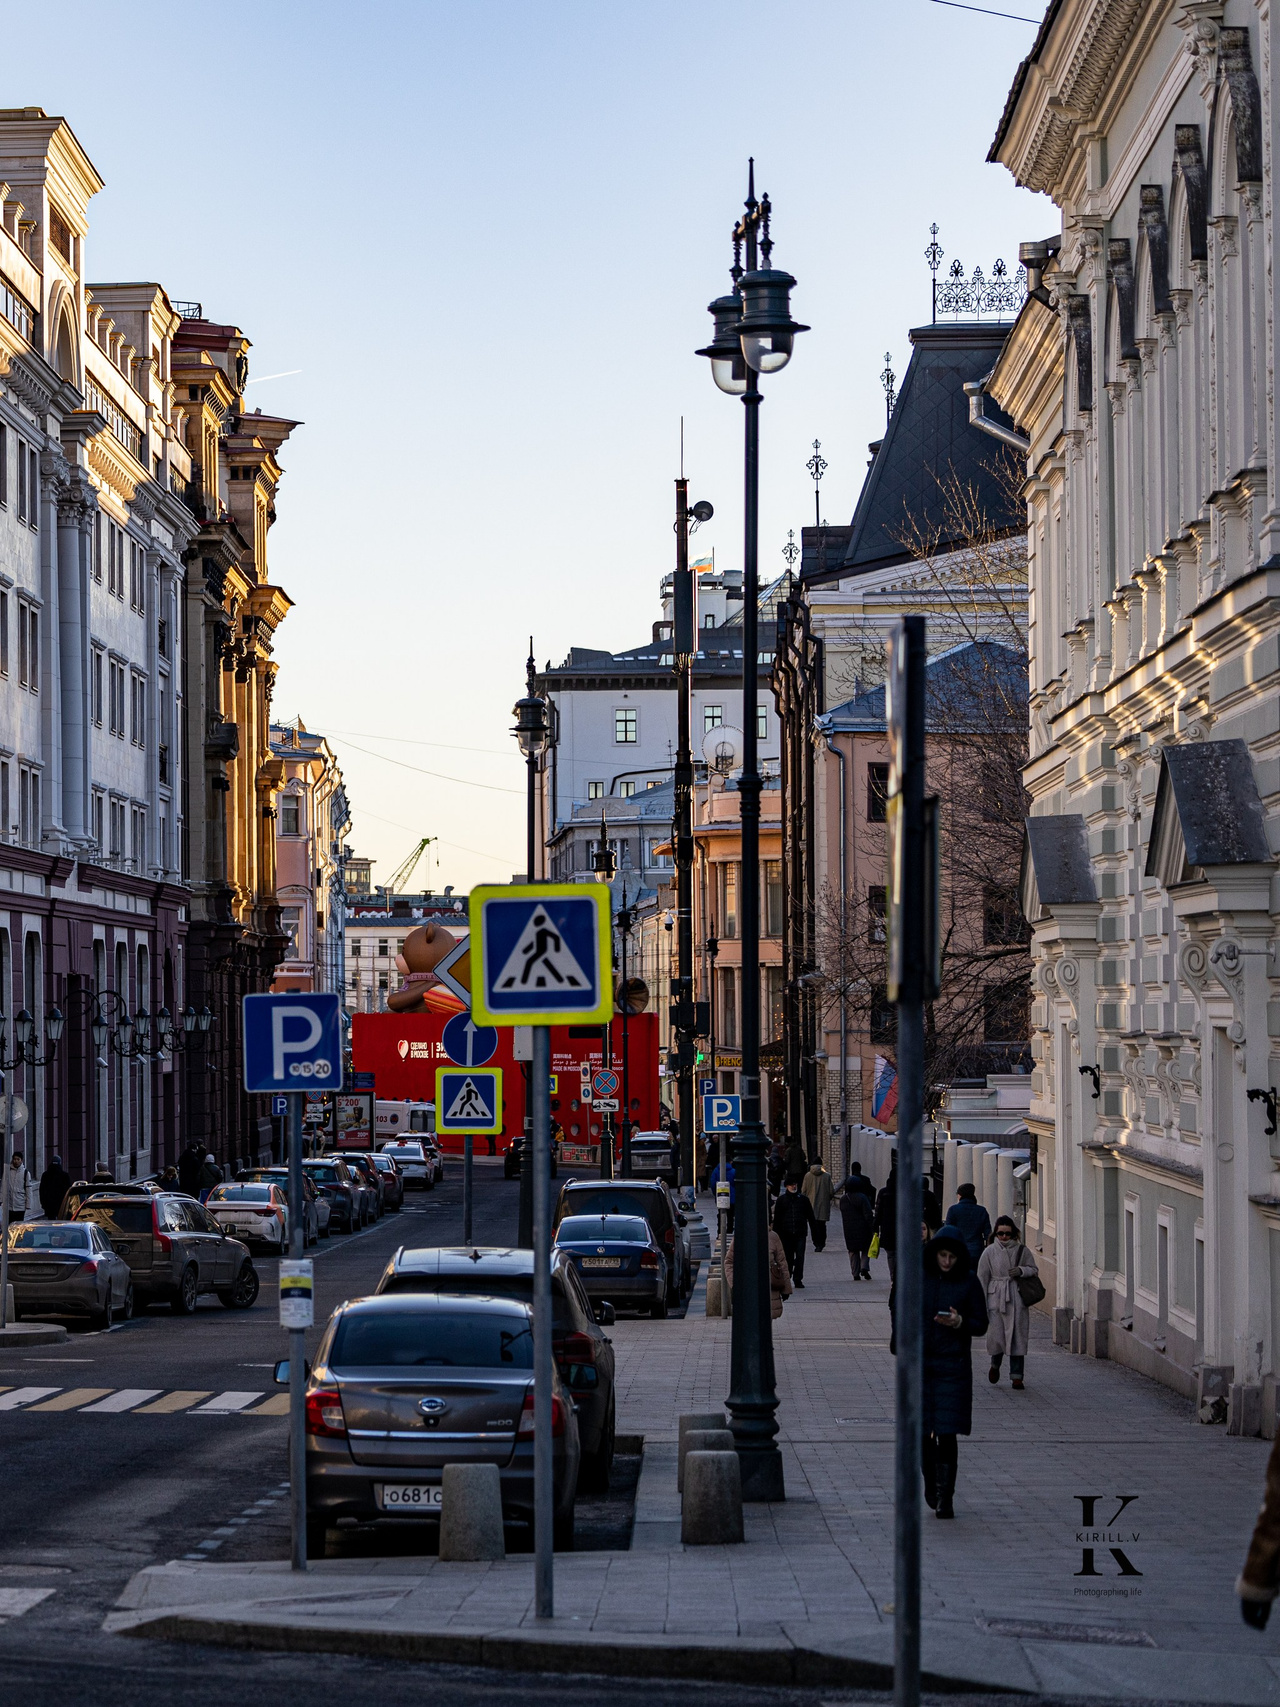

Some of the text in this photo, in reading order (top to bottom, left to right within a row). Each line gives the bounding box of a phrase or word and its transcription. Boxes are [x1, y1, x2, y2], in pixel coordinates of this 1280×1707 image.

[272, 1006, 322, 1080] P
[315, 1063, 329, 1074] 20
[720, 1057, 741, 1067] FRENC
[704, 1081, 713, 1094] P
[277, 1099, 287, 1113] P
[712, 1099, 732, 1127] P
